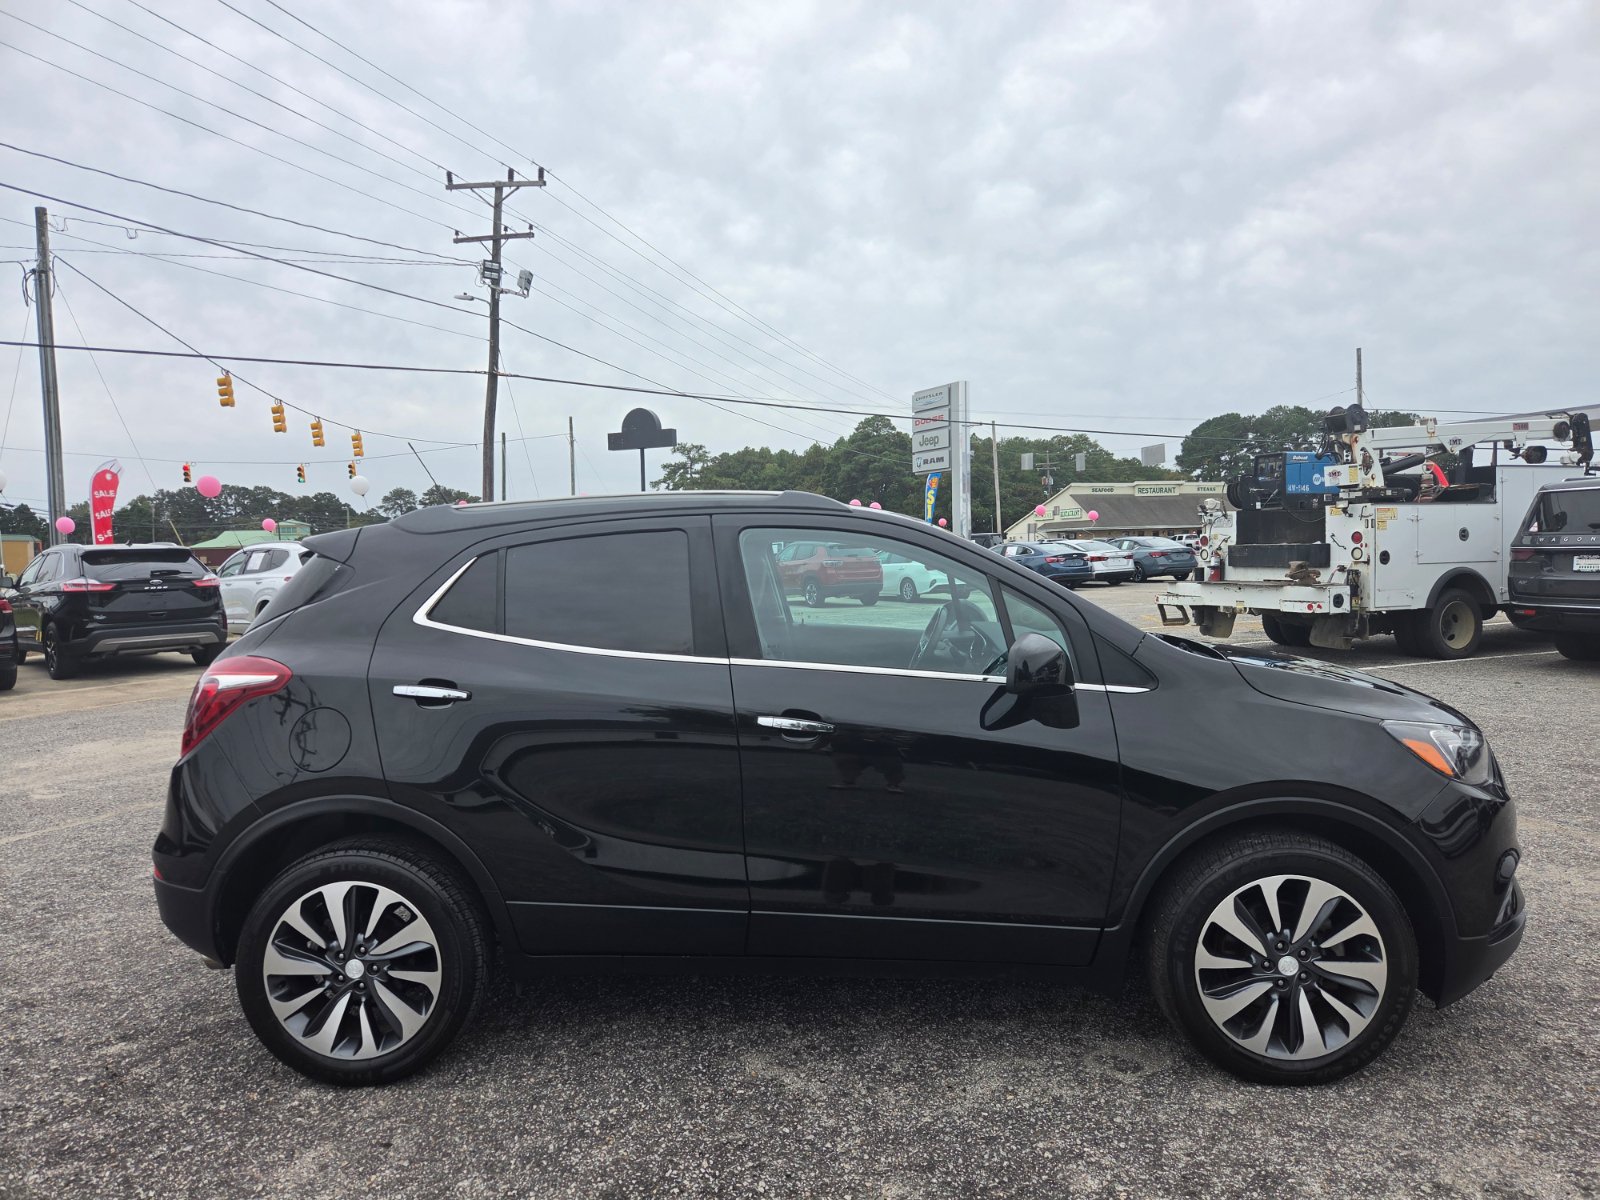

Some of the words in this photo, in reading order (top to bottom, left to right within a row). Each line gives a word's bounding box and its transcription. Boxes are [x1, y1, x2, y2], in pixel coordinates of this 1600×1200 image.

[918, 434, 939, 447] Jeep
[922, 456, 944, 465] RAM
[93, 489, 116, 499] SALE
[1137, 486, 1176, 495] RESTAURANT
